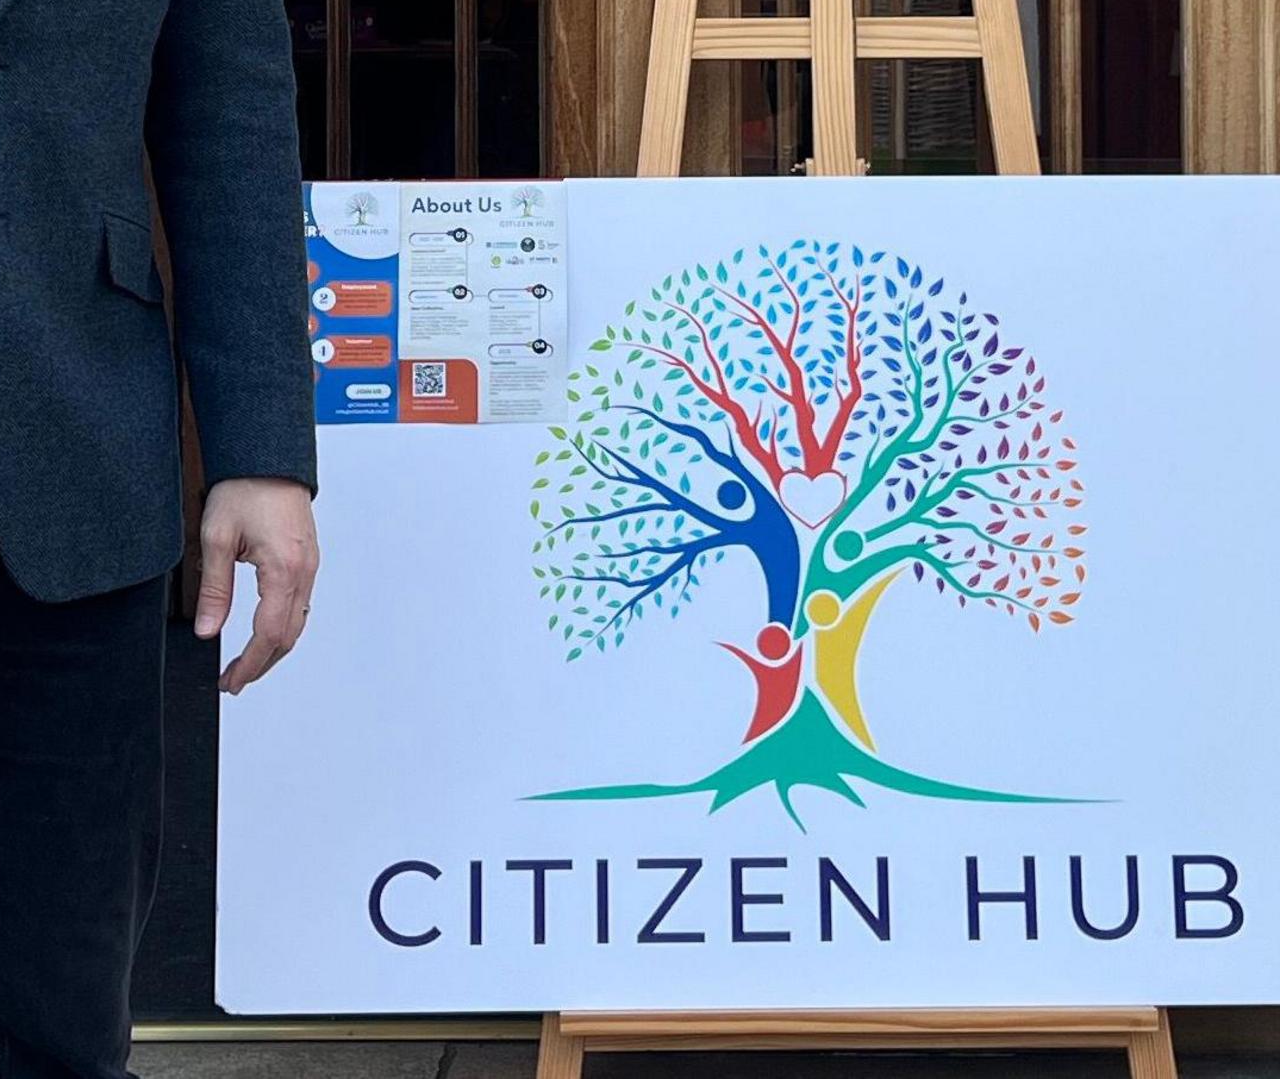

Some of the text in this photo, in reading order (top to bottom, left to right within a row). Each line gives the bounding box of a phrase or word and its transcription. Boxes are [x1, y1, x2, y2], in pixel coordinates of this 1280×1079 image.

[411, 197, 502, 213] About Us
[534, 341, 545, 349] 04
[369, 855, 1243, 947] CITIZEN HUB
